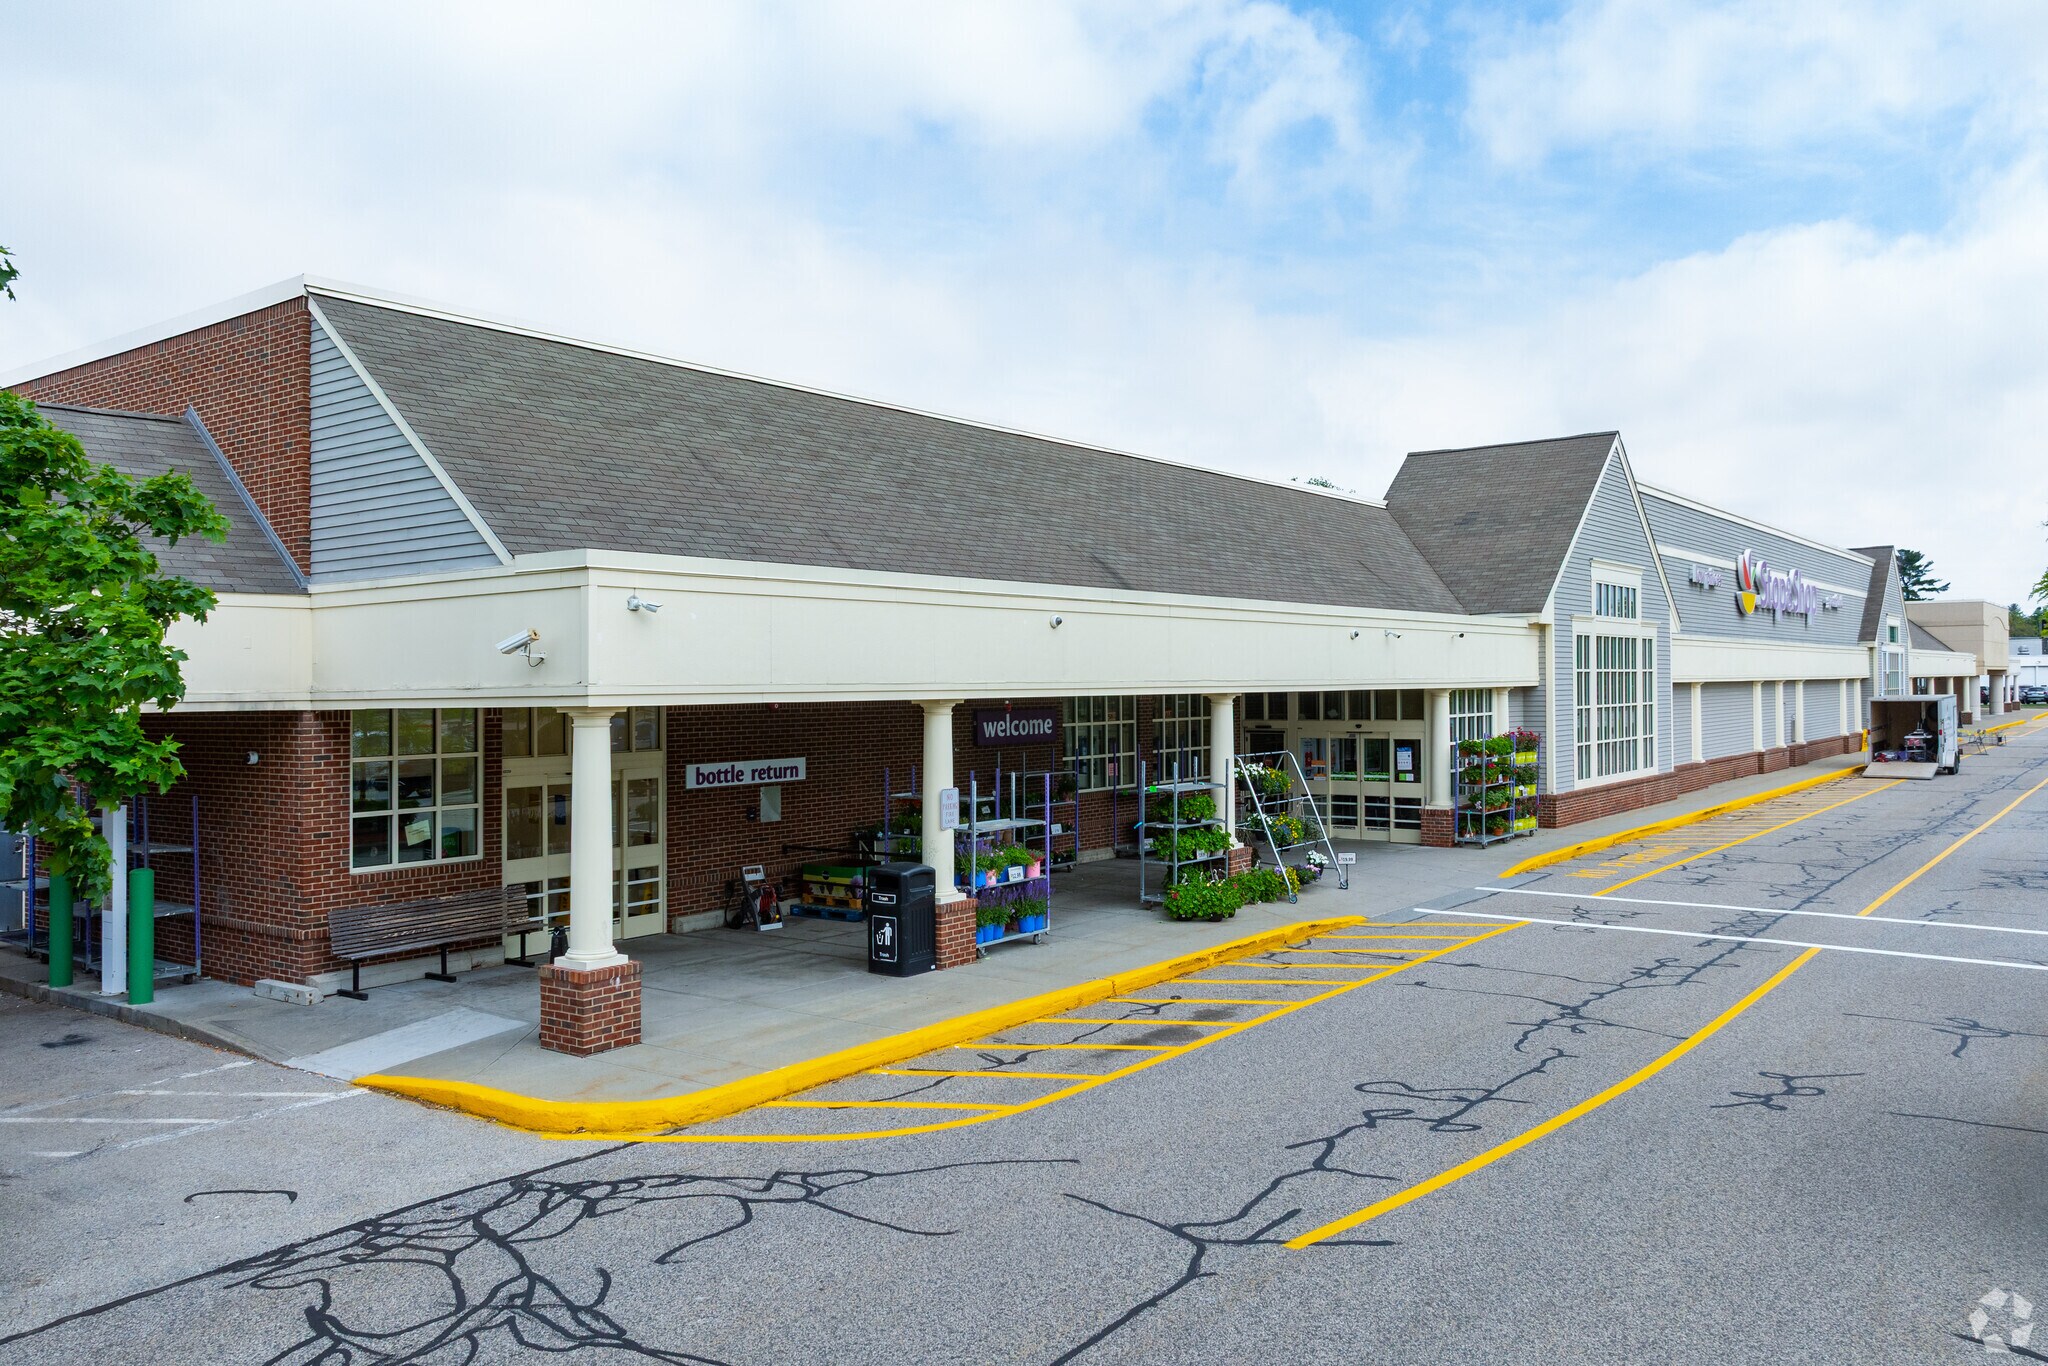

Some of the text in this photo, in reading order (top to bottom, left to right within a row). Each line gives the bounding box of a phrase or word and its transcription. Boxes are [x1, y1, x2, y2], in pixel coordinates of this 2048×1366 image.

[983, 714, 1053, 738] welcome
[695, 764, 799, 786] bottle return
